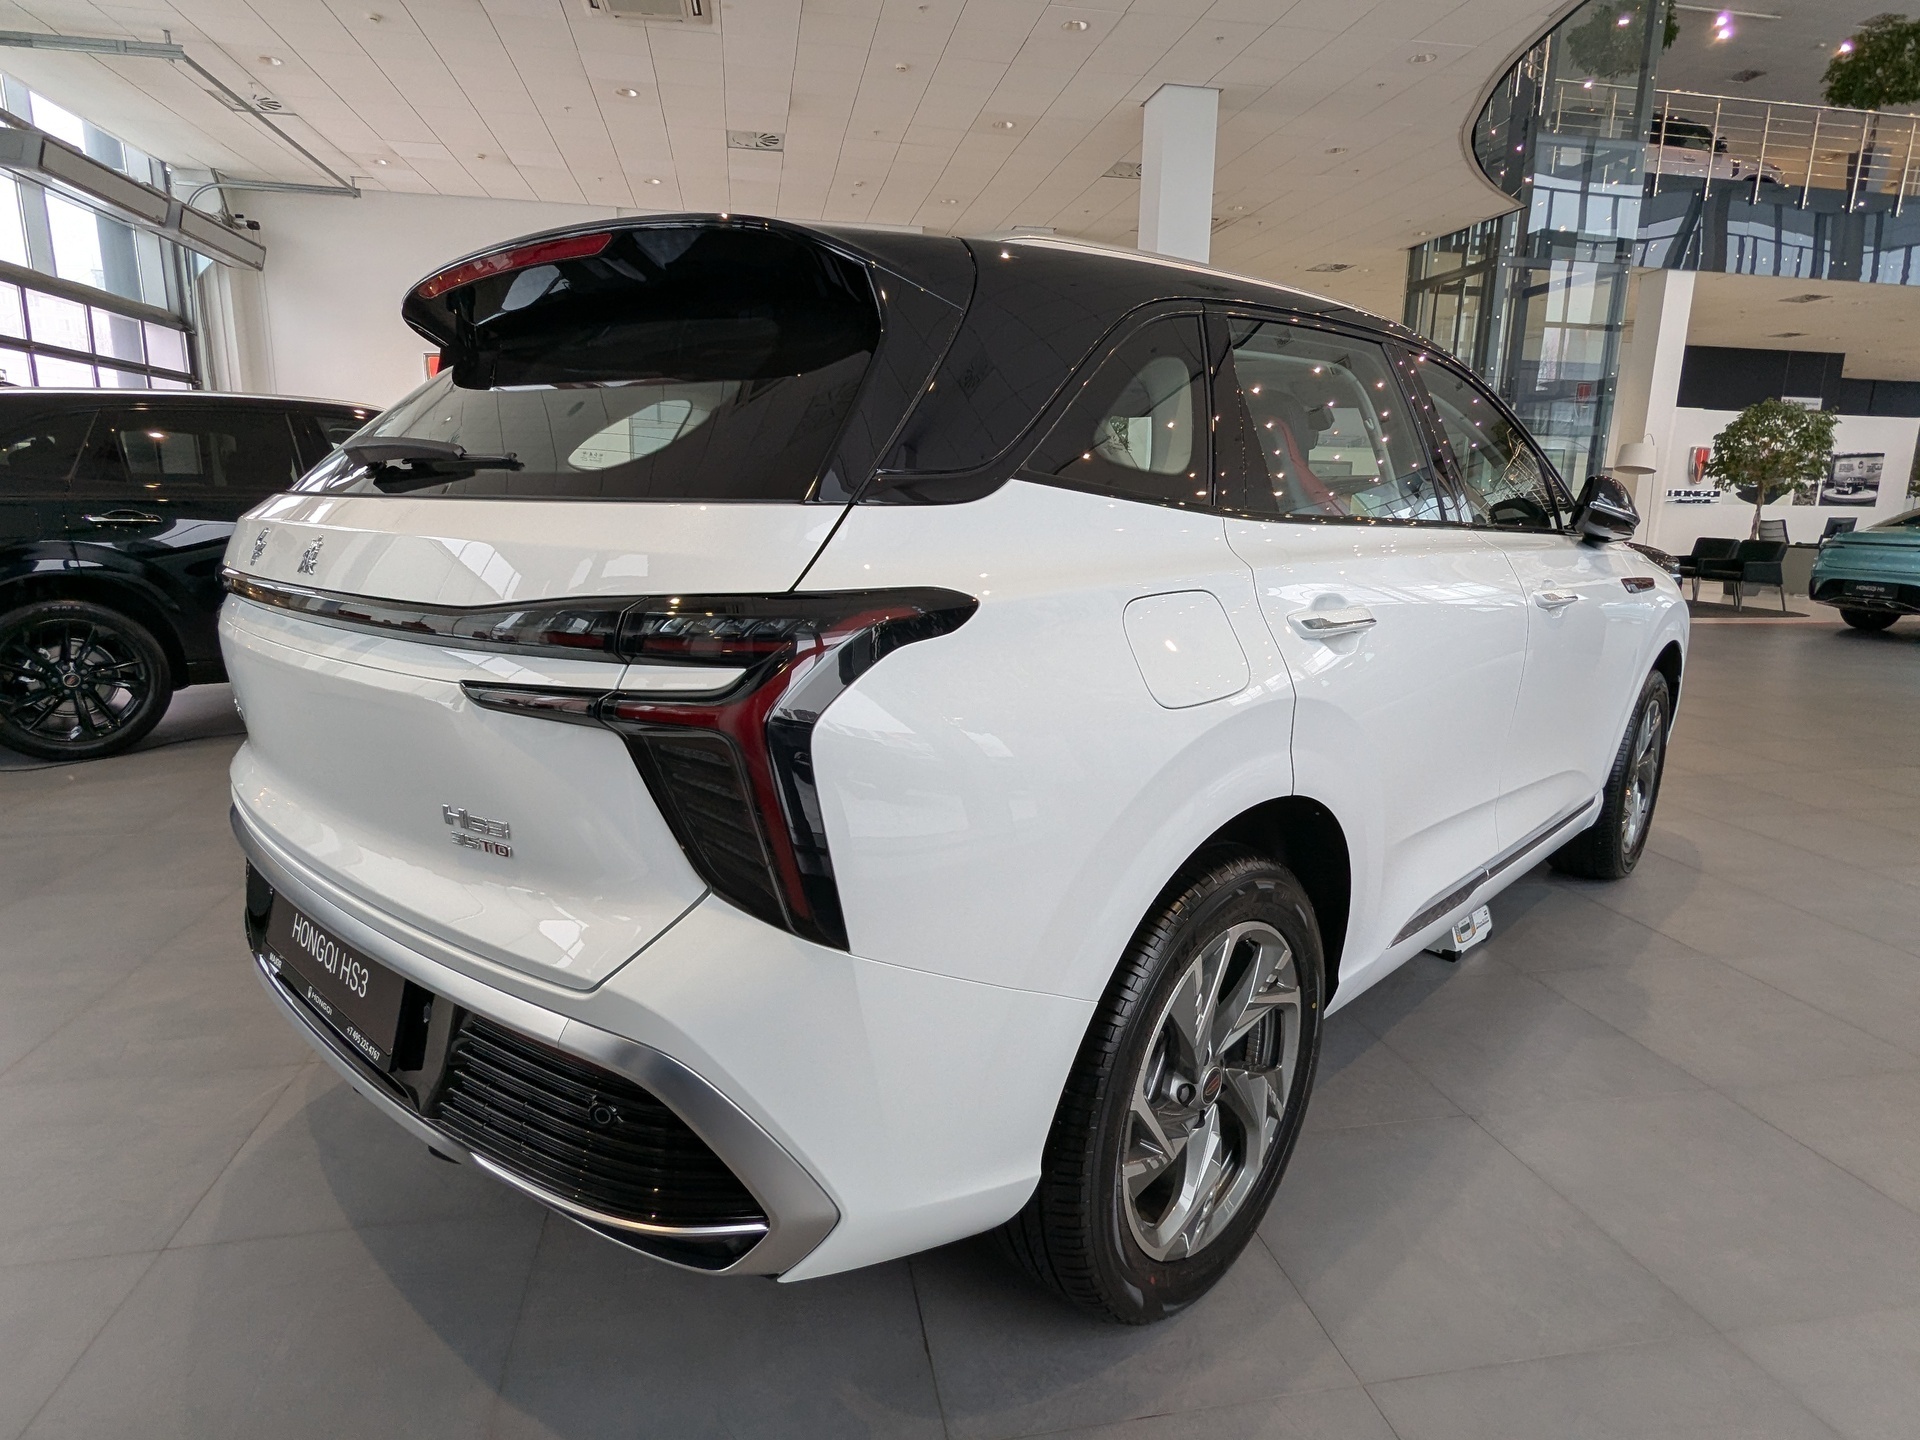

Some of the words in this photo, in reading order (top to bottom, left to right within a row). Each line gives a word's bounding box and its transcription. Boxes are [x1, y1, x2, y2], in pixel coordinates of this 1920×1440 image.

[442, 803, 509, 839] HS3
[292, 912, 339, 974] HONGQI
[339, 952, 369, 998] HS3
[311, 991, 333, 1015] HONGQI
